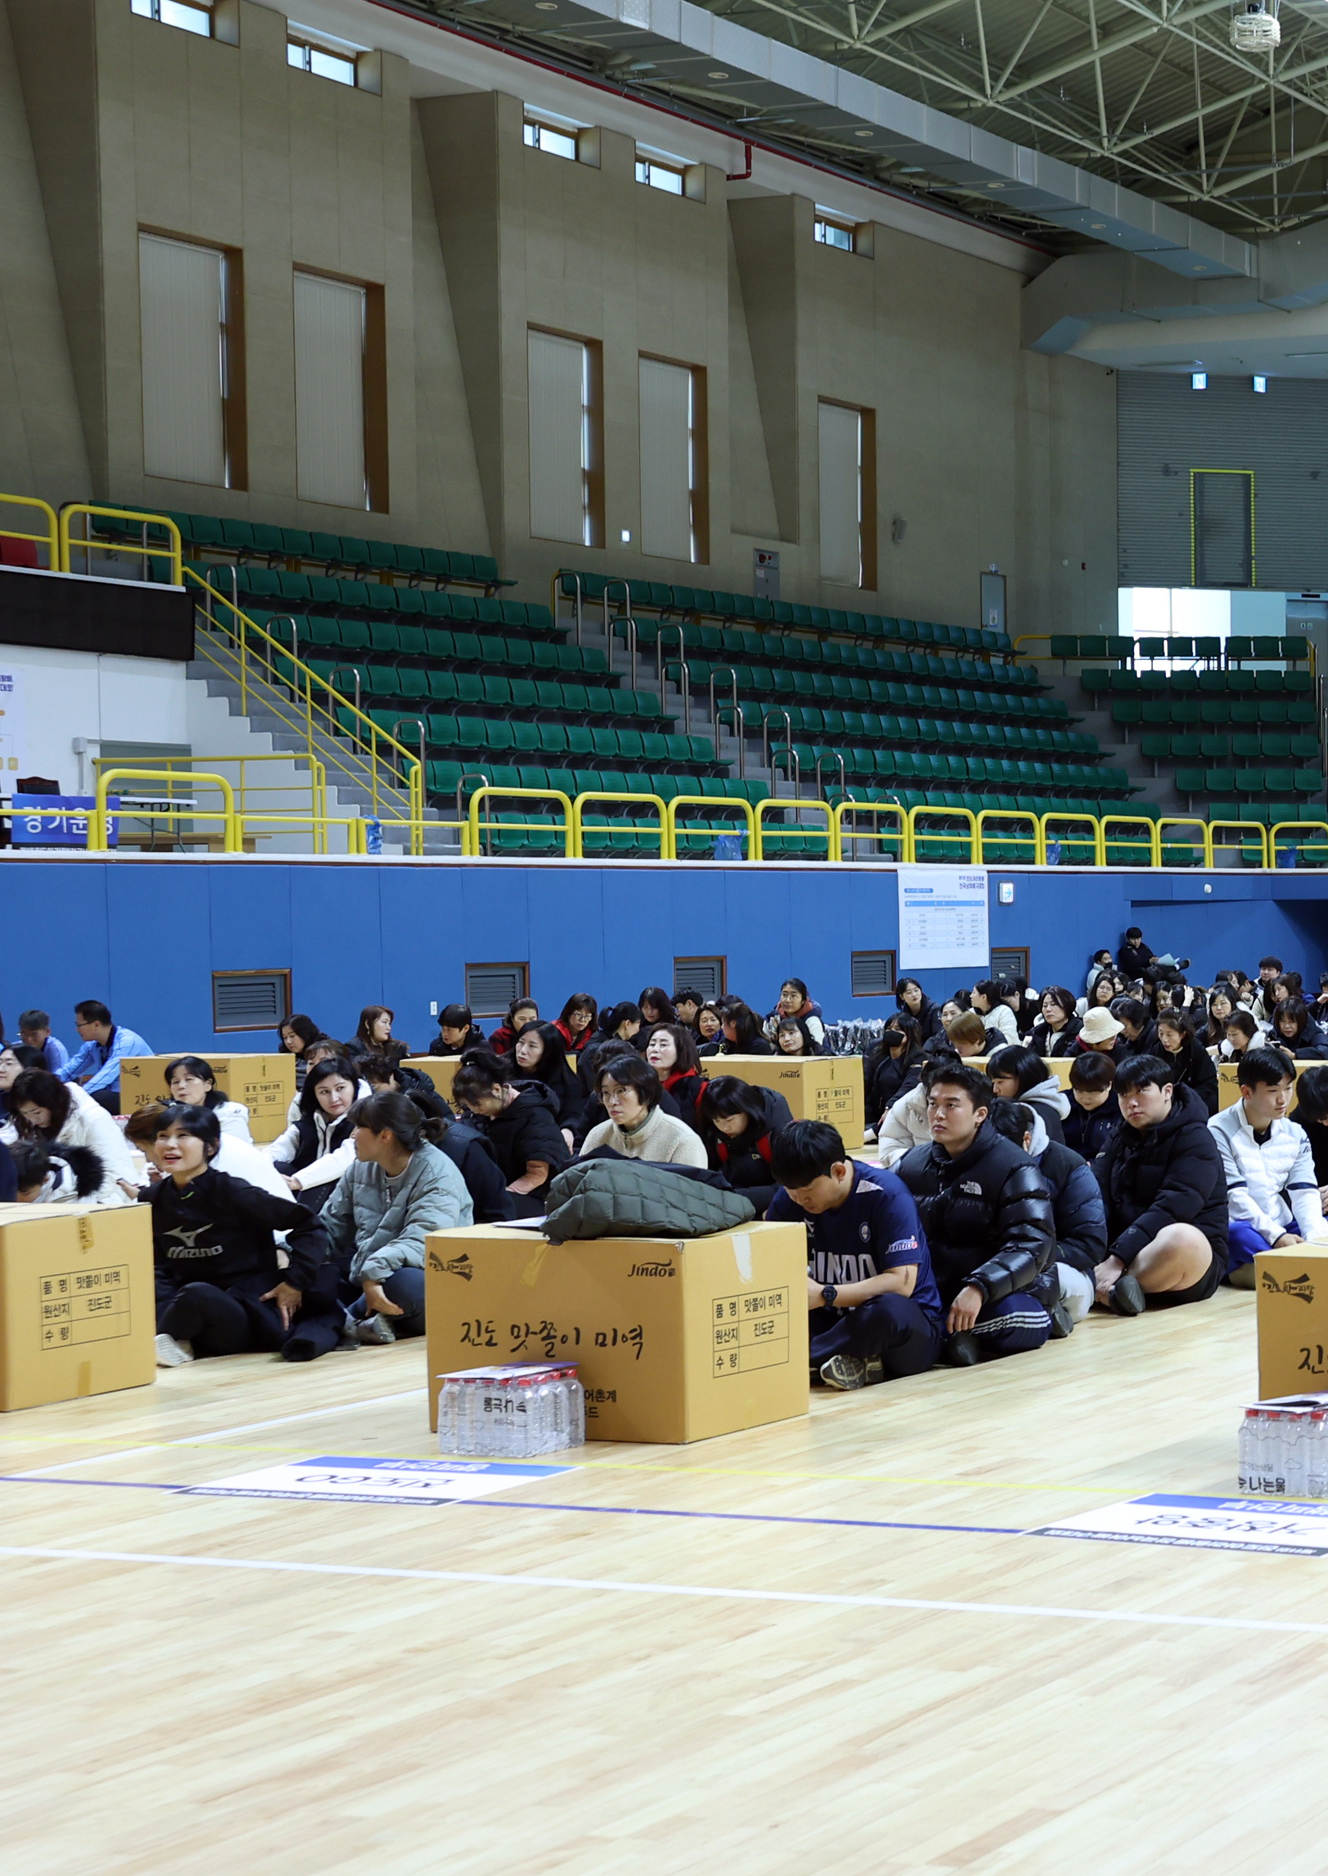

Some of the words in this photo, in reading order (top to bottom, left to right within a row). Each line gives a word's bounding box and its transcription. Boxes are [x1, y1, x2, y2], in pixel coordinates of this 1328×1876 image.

[105, 1271, 121, 1285] 미역
[628, 1263, 669, 1279] Jindo
[43, 1303, 70, 1319] 원산지
[88, 1296, 112, 1312] 진도군
[768, 1293, 783, 1309] 미역
[460, 1319, 499, 1348] 진도
[595, 1324, 644, 1361] 미역
[715, 1326, 738, 1344] 원산지
[753, 1320, 775, 1338] 진도군
[716, 1353, 737, 1370] 수량
[291, 1472, 453, 1489] 진도GO
